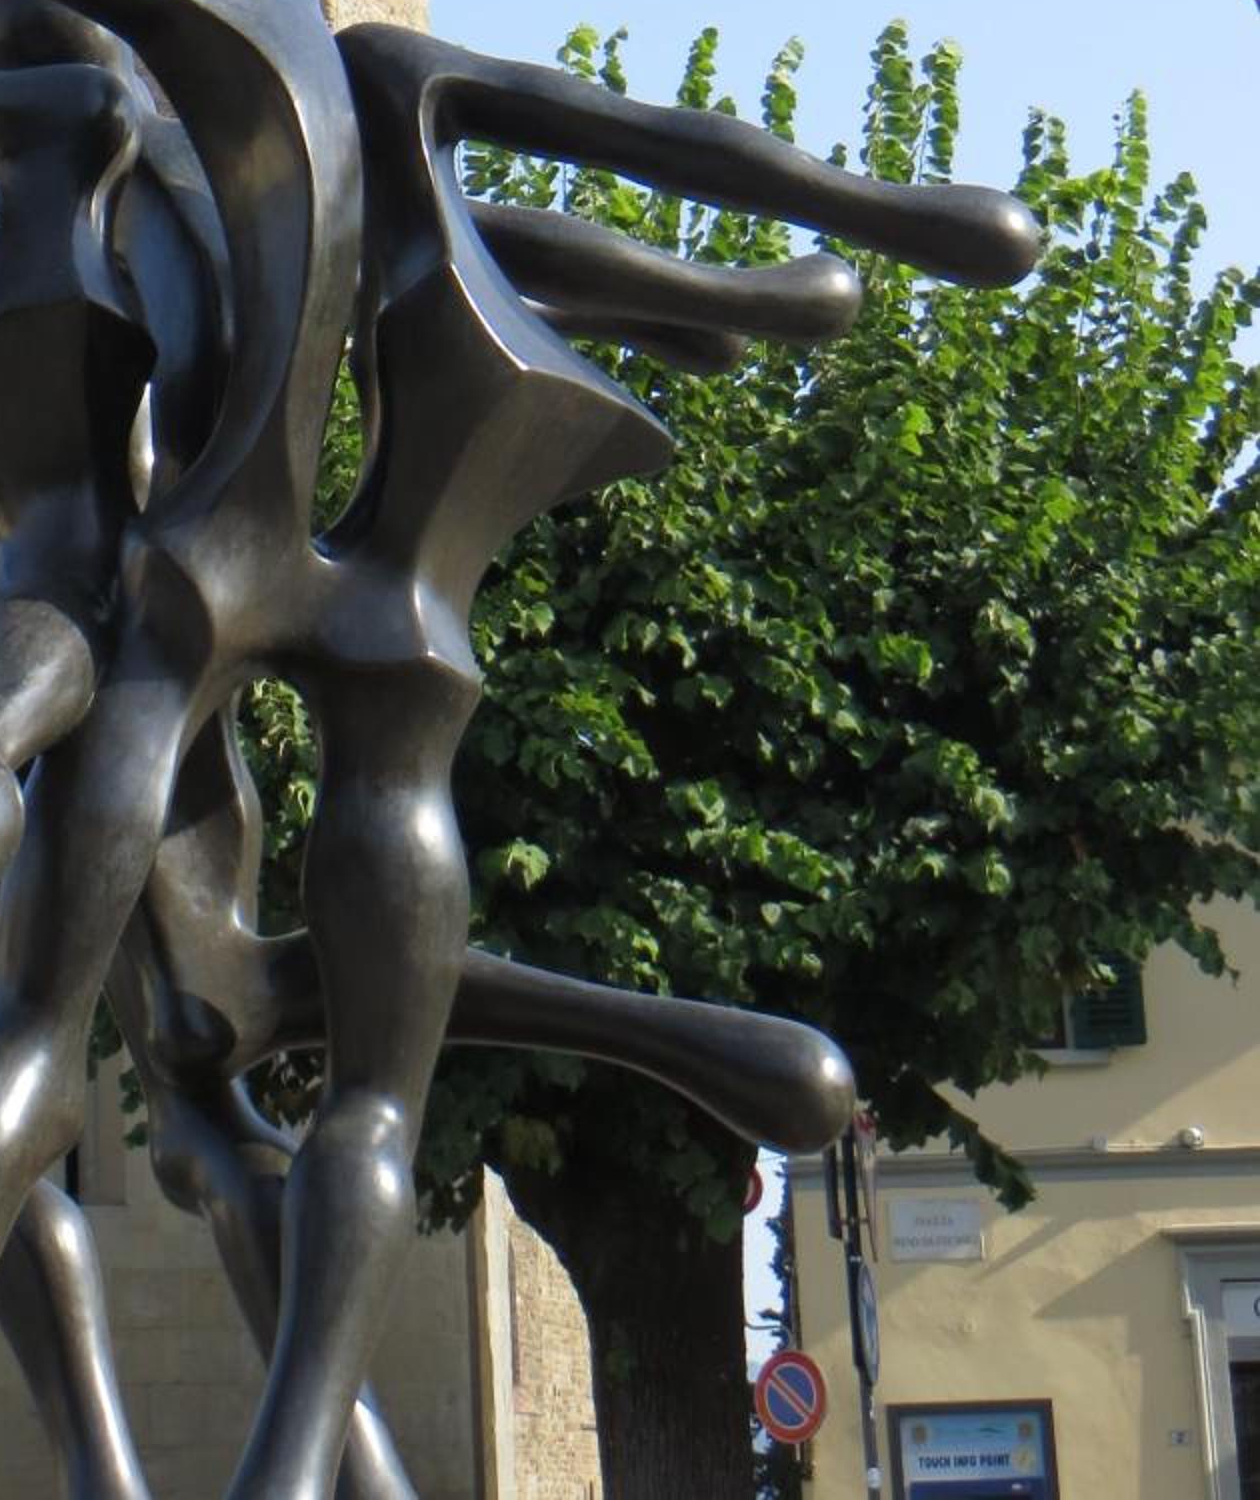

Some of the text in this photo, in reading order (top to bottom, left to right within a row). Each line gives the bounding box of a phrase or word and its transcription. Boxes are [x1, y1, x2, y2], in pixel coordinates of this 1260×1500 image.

[918, 1454, 1010, 1469] TOUCH INFO POINT
